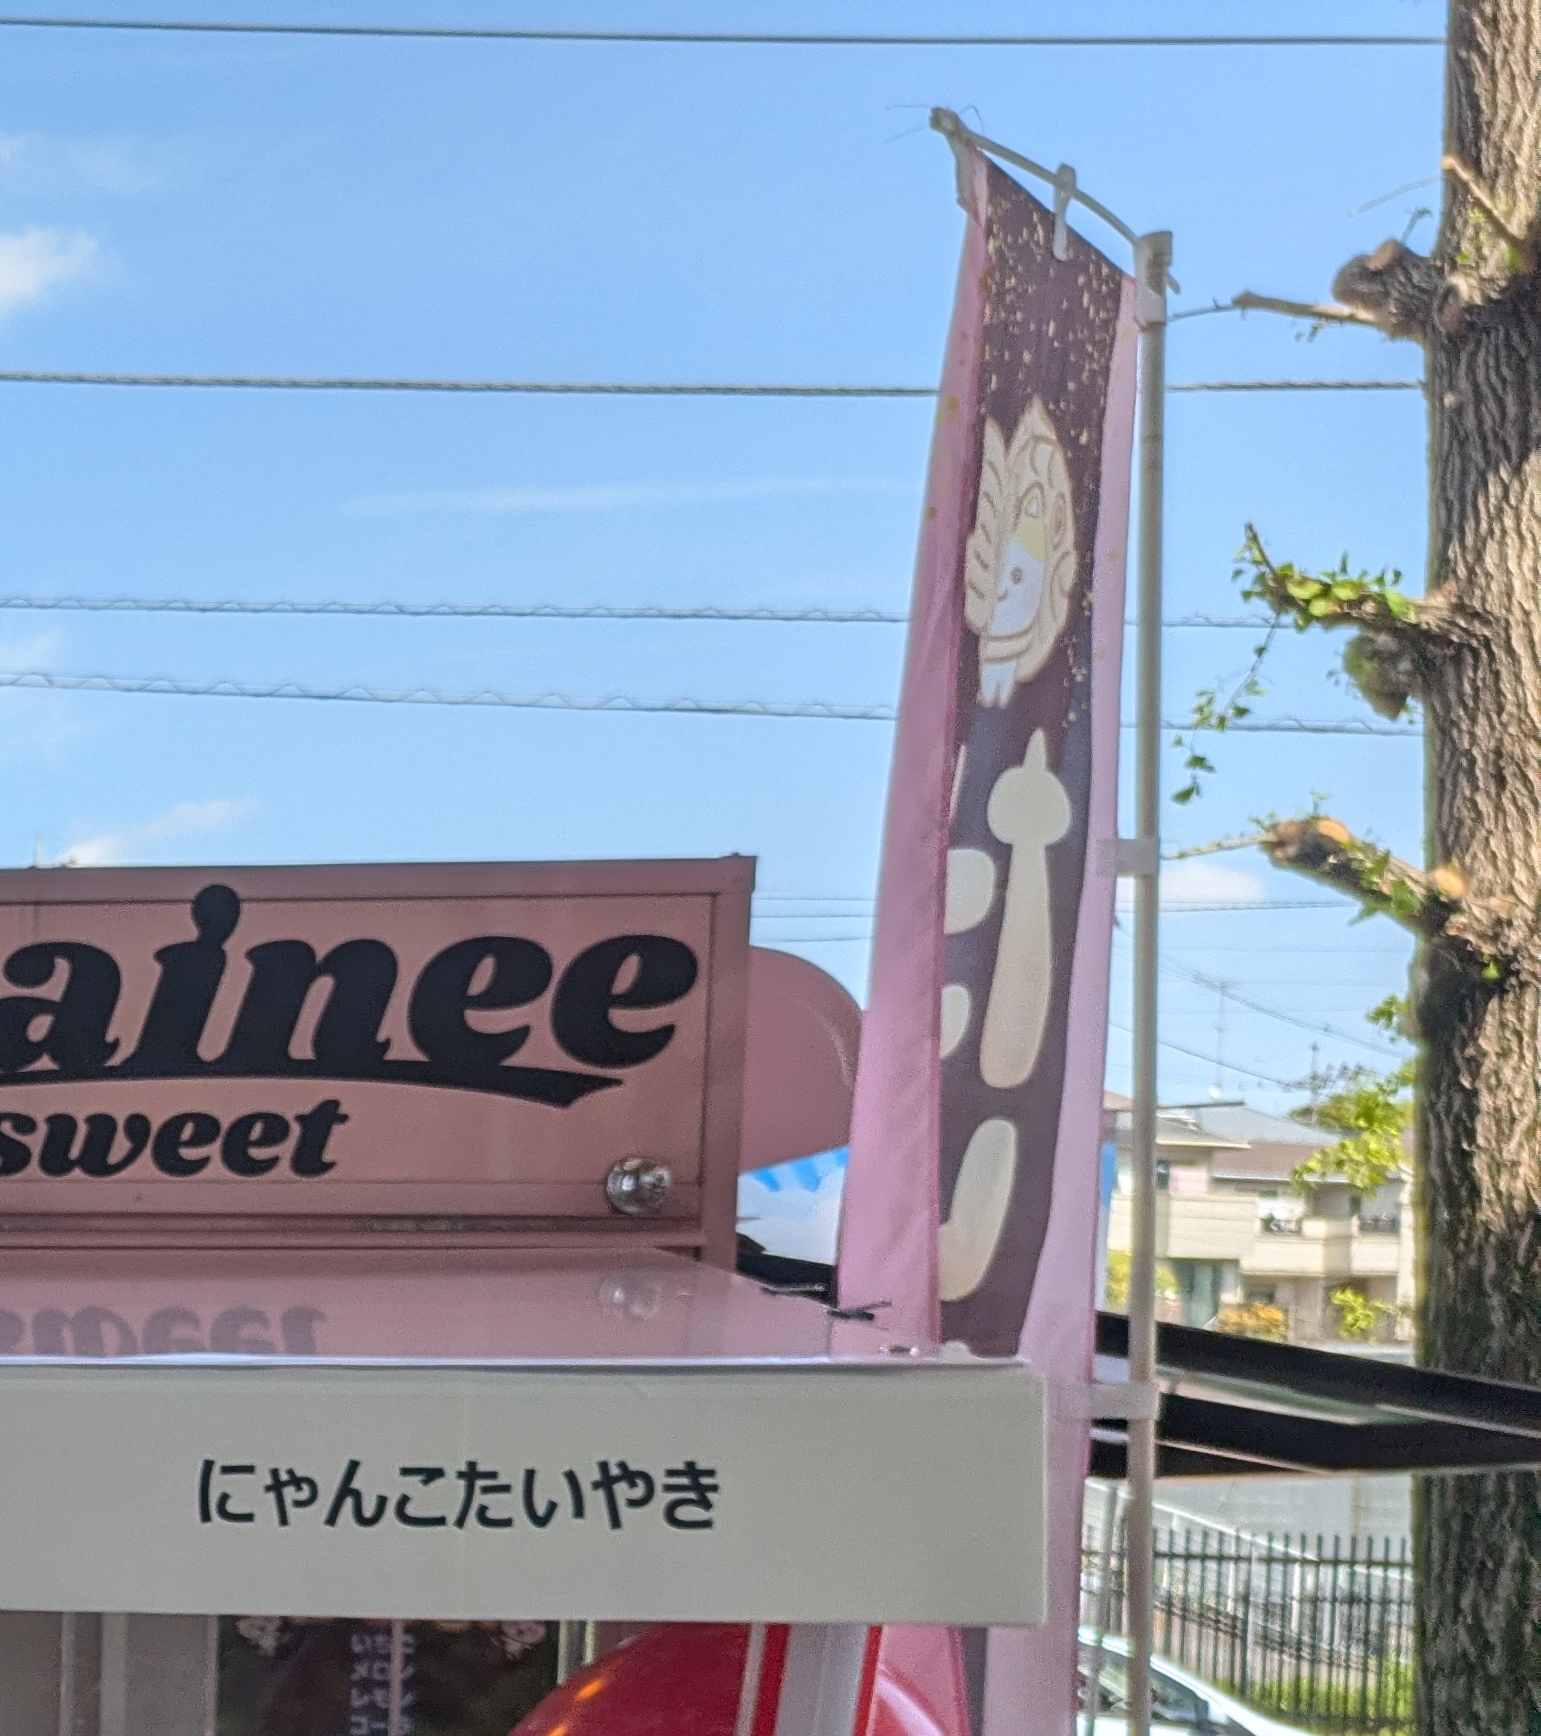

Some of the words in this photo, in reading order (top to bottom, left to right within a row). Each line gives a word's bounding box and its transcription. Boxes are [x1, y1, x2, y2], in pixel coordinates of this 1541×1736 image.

[197, 1459, 720, 1531] にゃんこたいやき
